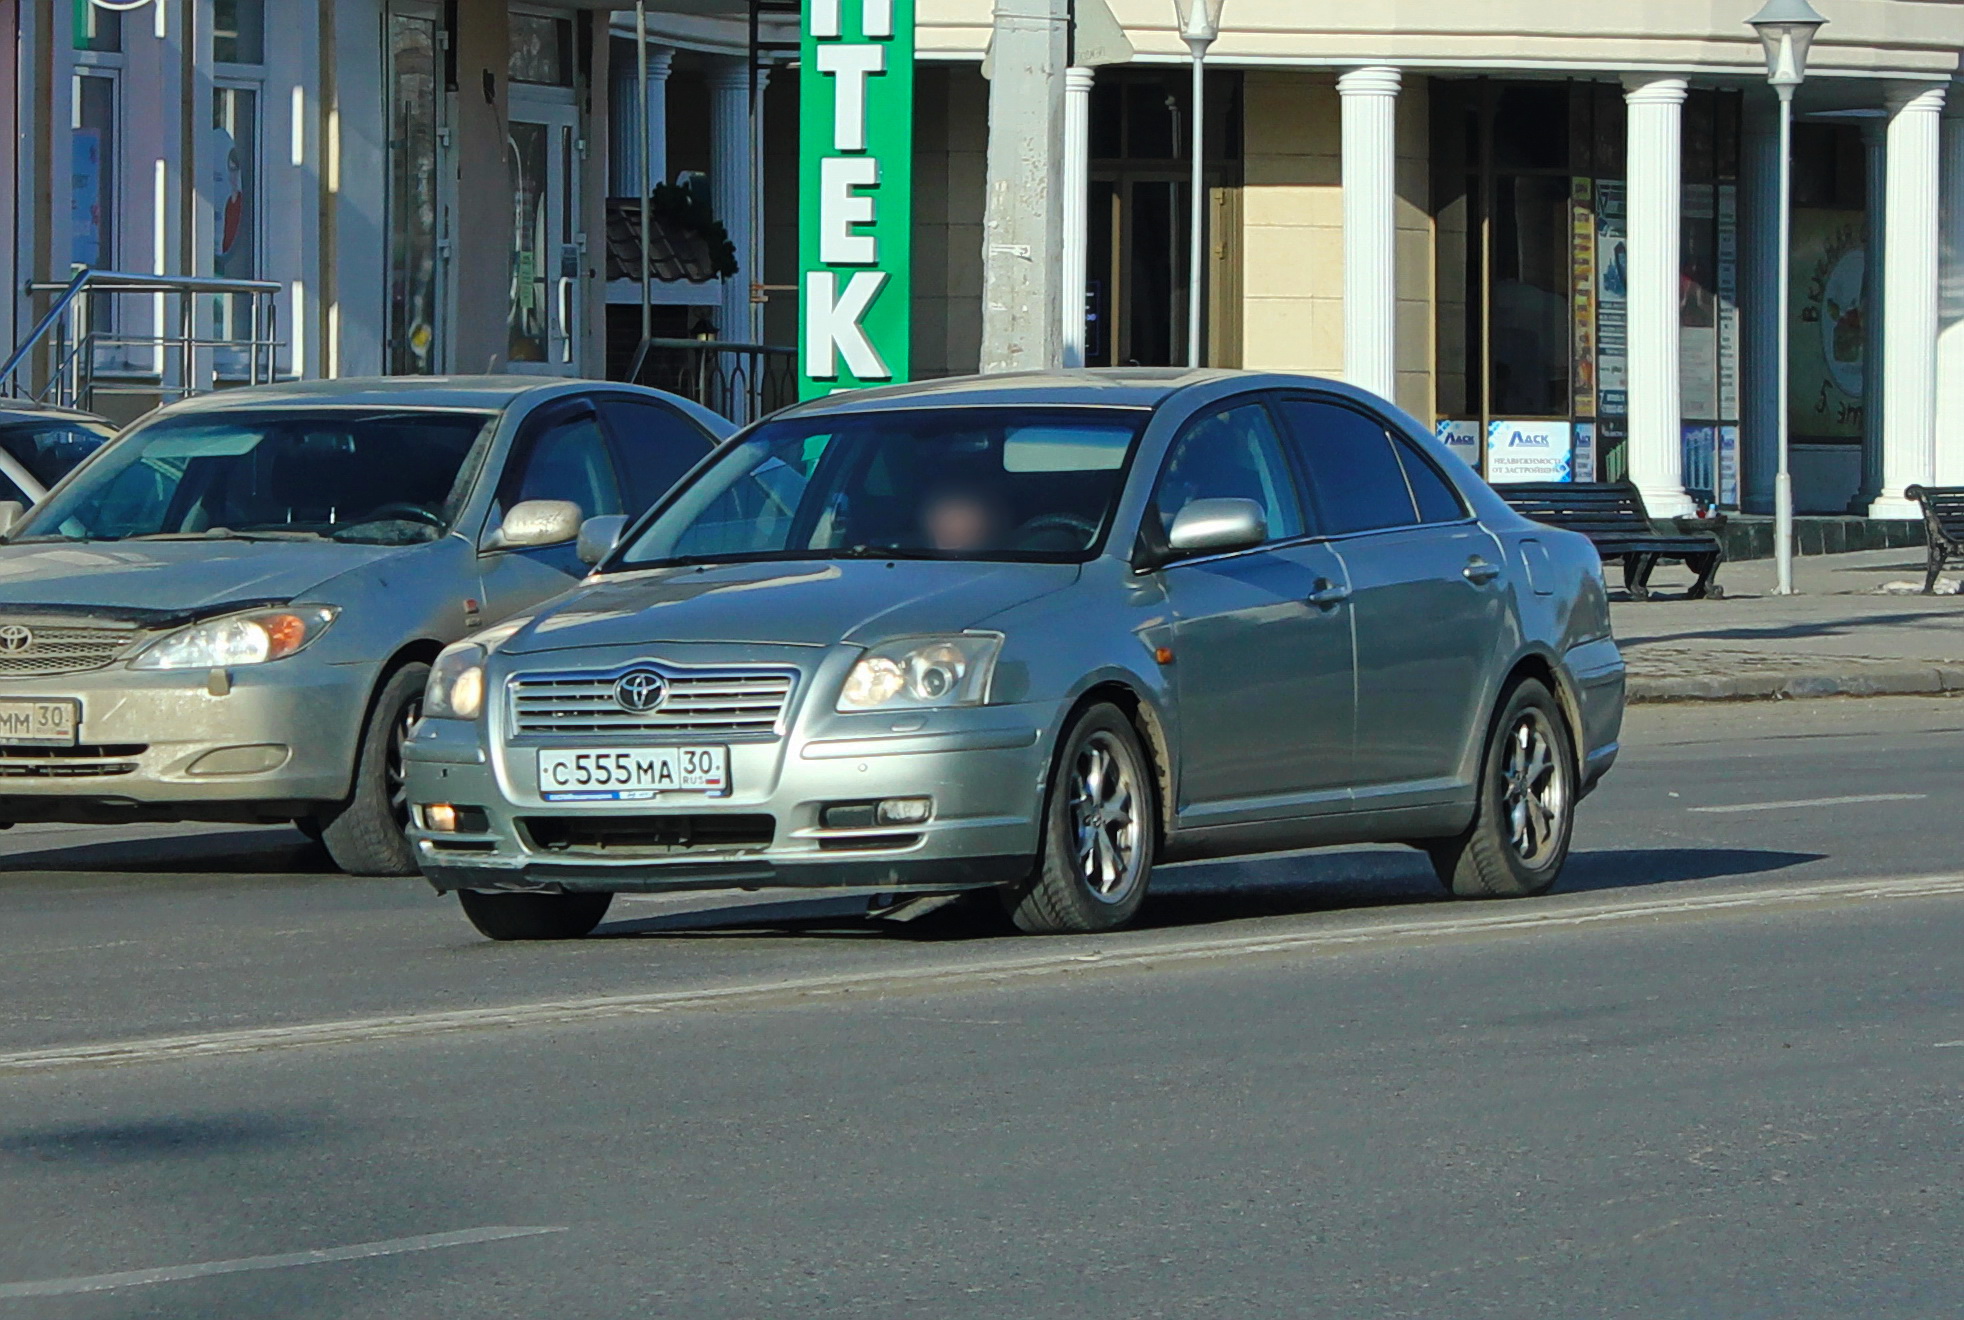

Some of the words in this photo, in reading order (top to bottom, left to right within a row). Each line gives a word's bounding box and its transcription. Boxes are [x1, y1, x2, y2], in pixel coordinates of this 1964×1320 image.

[806, 0, 893, 395] ТЕК
[38, 706, 63, 727] 30
[682, 750, 713, 775] 30
[682, 775, 705, 785] RUS
